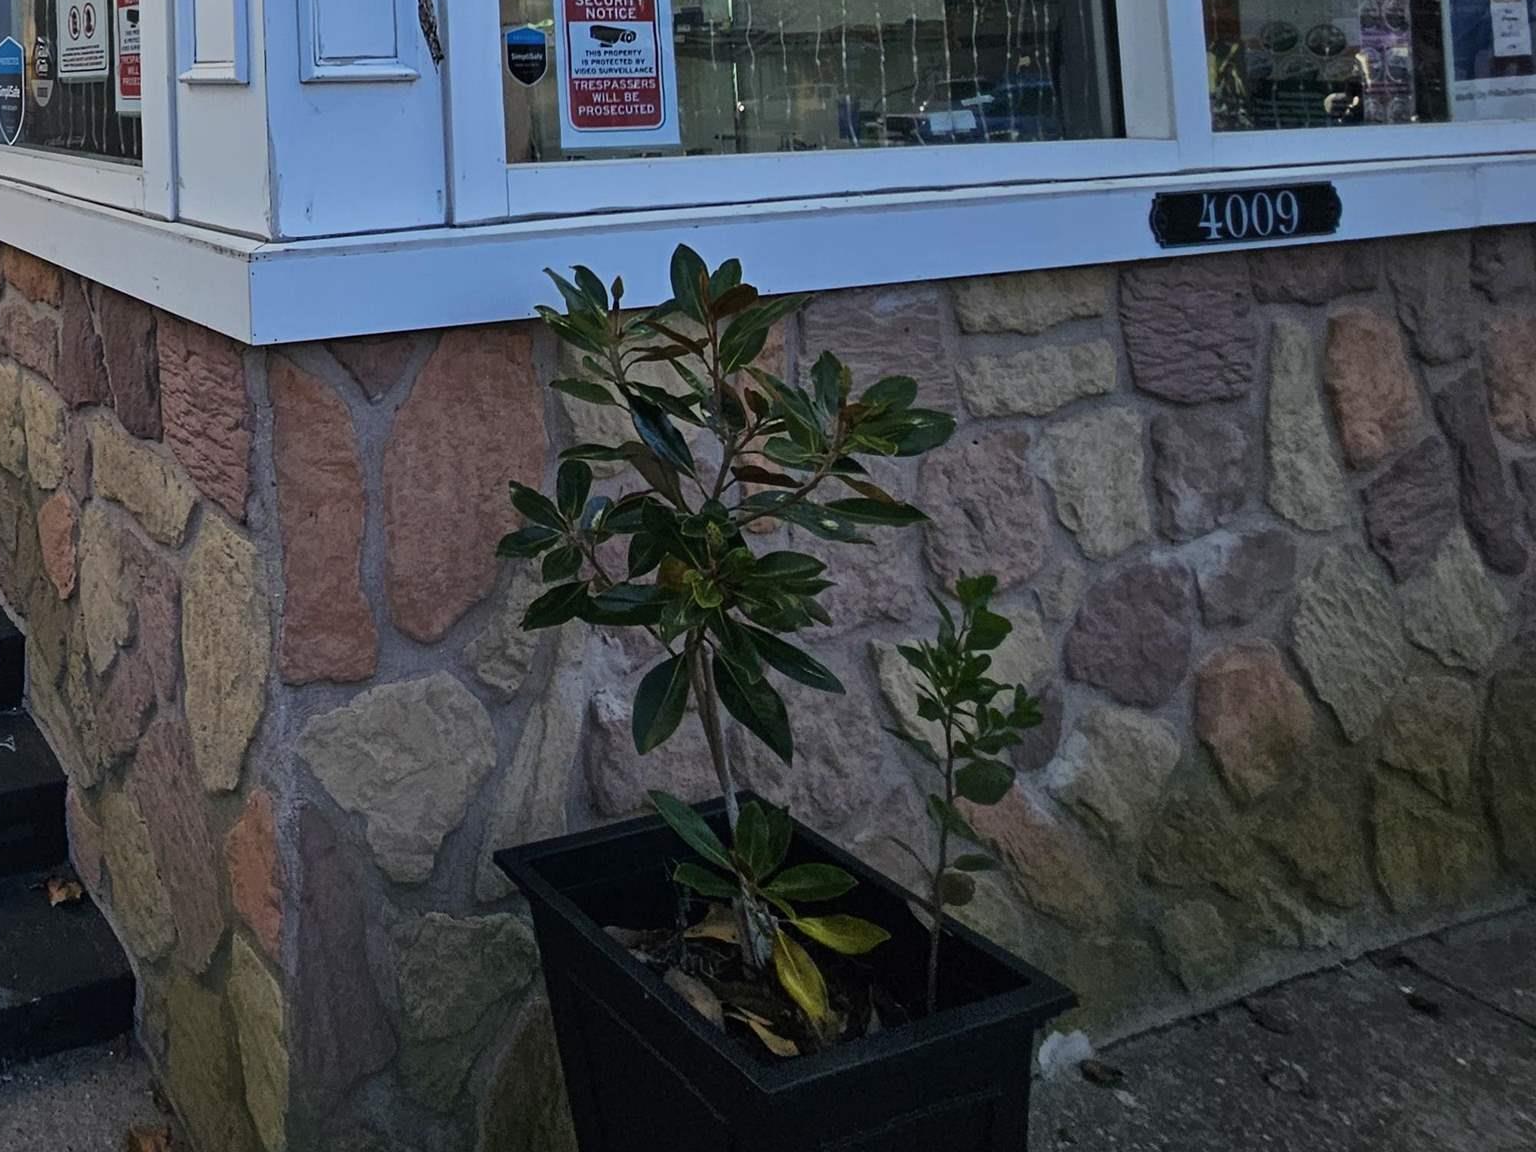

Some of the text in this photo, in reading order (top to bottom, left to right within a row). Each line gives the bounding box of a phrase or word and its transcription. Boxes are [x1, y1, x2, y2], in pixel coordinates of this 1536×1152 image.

[586, 8, 637, 19] NOTICE
[604, 49, 642, 57] PROPERTY
[591, 58, 633, 66] PROTECTED
[574, 67, 654, 75] VIDEO SURVEILLANCE
[574, 79, 656, 90] TRESPASSERS
[592, 91, 640, 103] WILL BE
[578, 104, 654, 116] PROSECUTED
[1198, 190, 1299, 239] 4009
